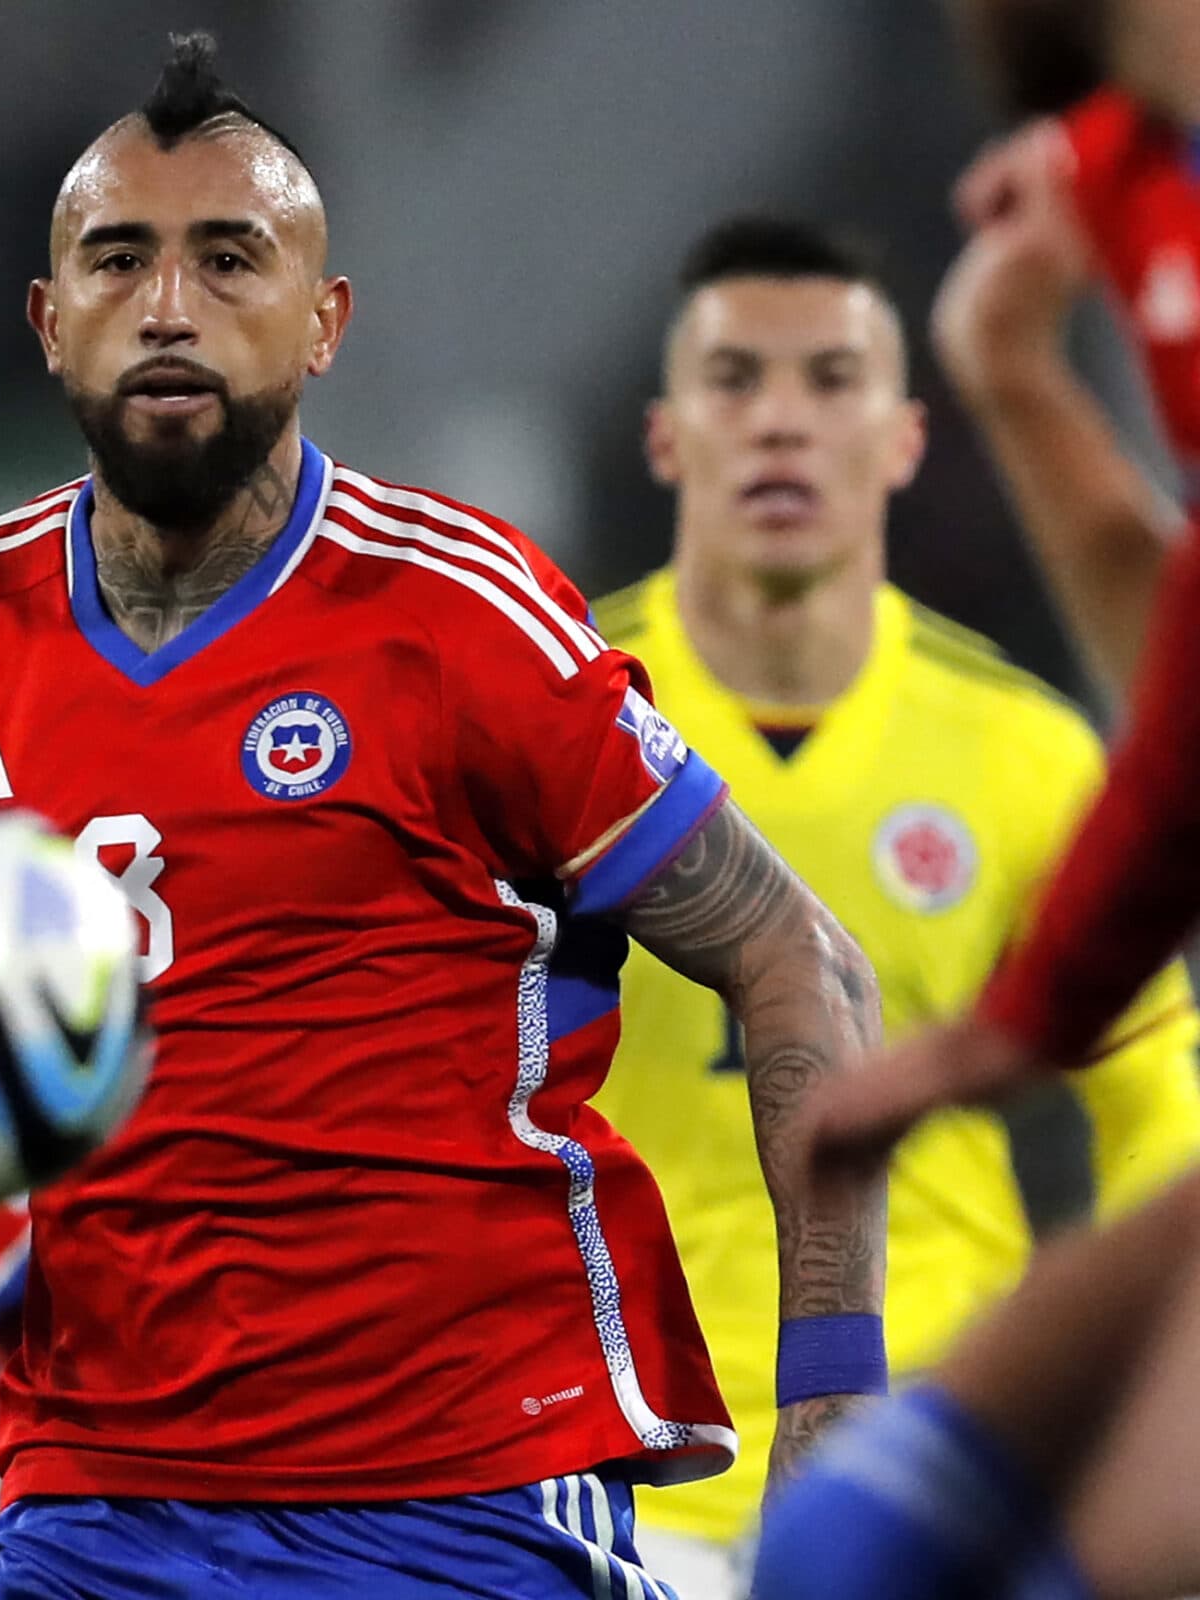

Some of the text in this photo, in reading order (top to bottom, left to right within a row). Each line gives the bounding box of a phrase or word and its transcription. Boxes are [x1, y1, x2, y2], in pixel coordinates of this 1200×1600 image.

[305, 698, 320, 711] DE
[321, 707, 348, 748] FUTBOL
[265, 780, 322, 796] DE CHILE
[73, 813, 174, 983] 8
